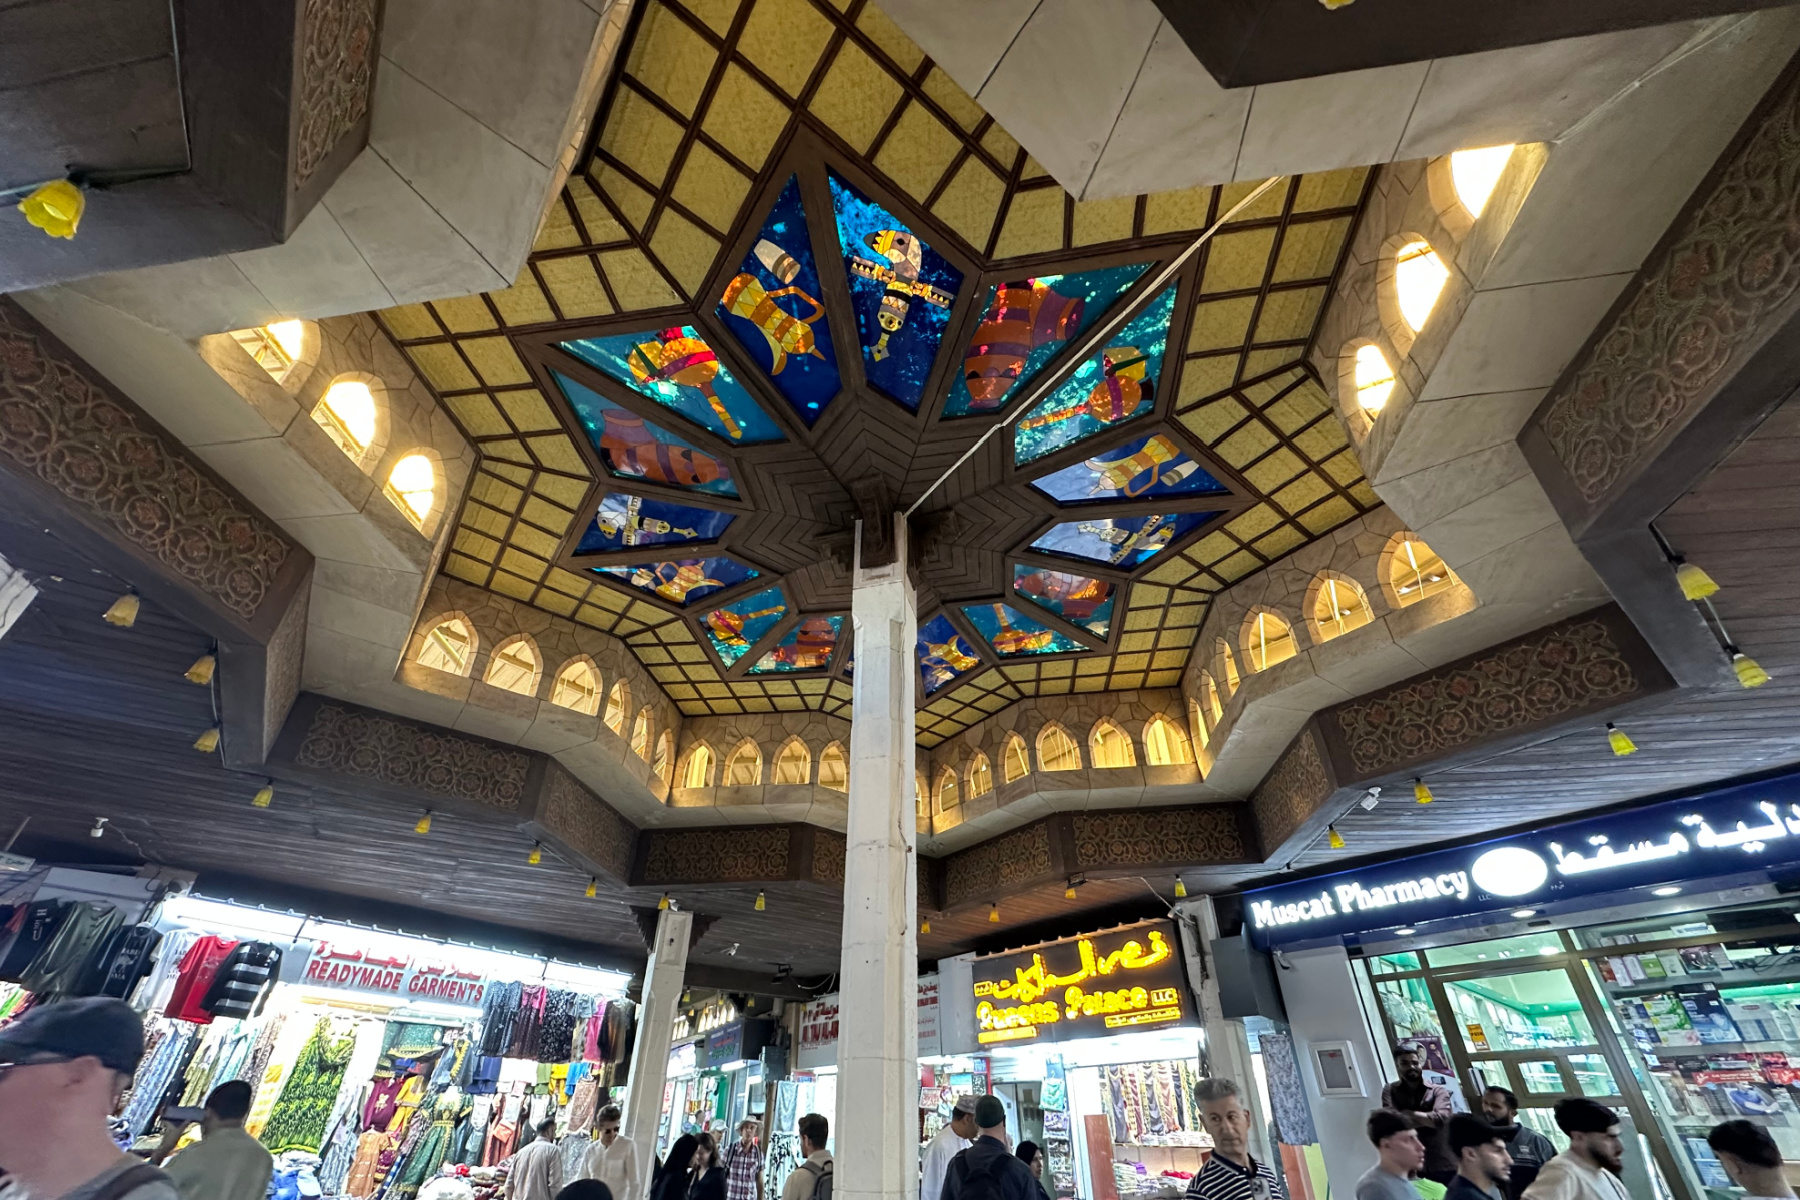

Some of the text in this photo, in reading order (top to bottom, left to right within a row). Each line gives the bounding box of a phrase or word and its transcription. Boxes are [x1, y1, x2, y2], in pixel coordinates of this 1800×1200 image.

[1551, 832, 1690, 876] مسقط
[1251, 870, 1470, 929] Muscat Pharmacy
[1478, 894, 1492, 902] LLC
[315, 940, 488, 982] الملابس الجاهزة
[1098, 930, 1169, 974] قصر
[306, 959, 484, 1002] READYMADE GARMENTS
[1153, 991, 1174, 1003] LLC
[976, 1001, 1060, 1030] Queens
[1065, 986, 1148, 1020] Palace
